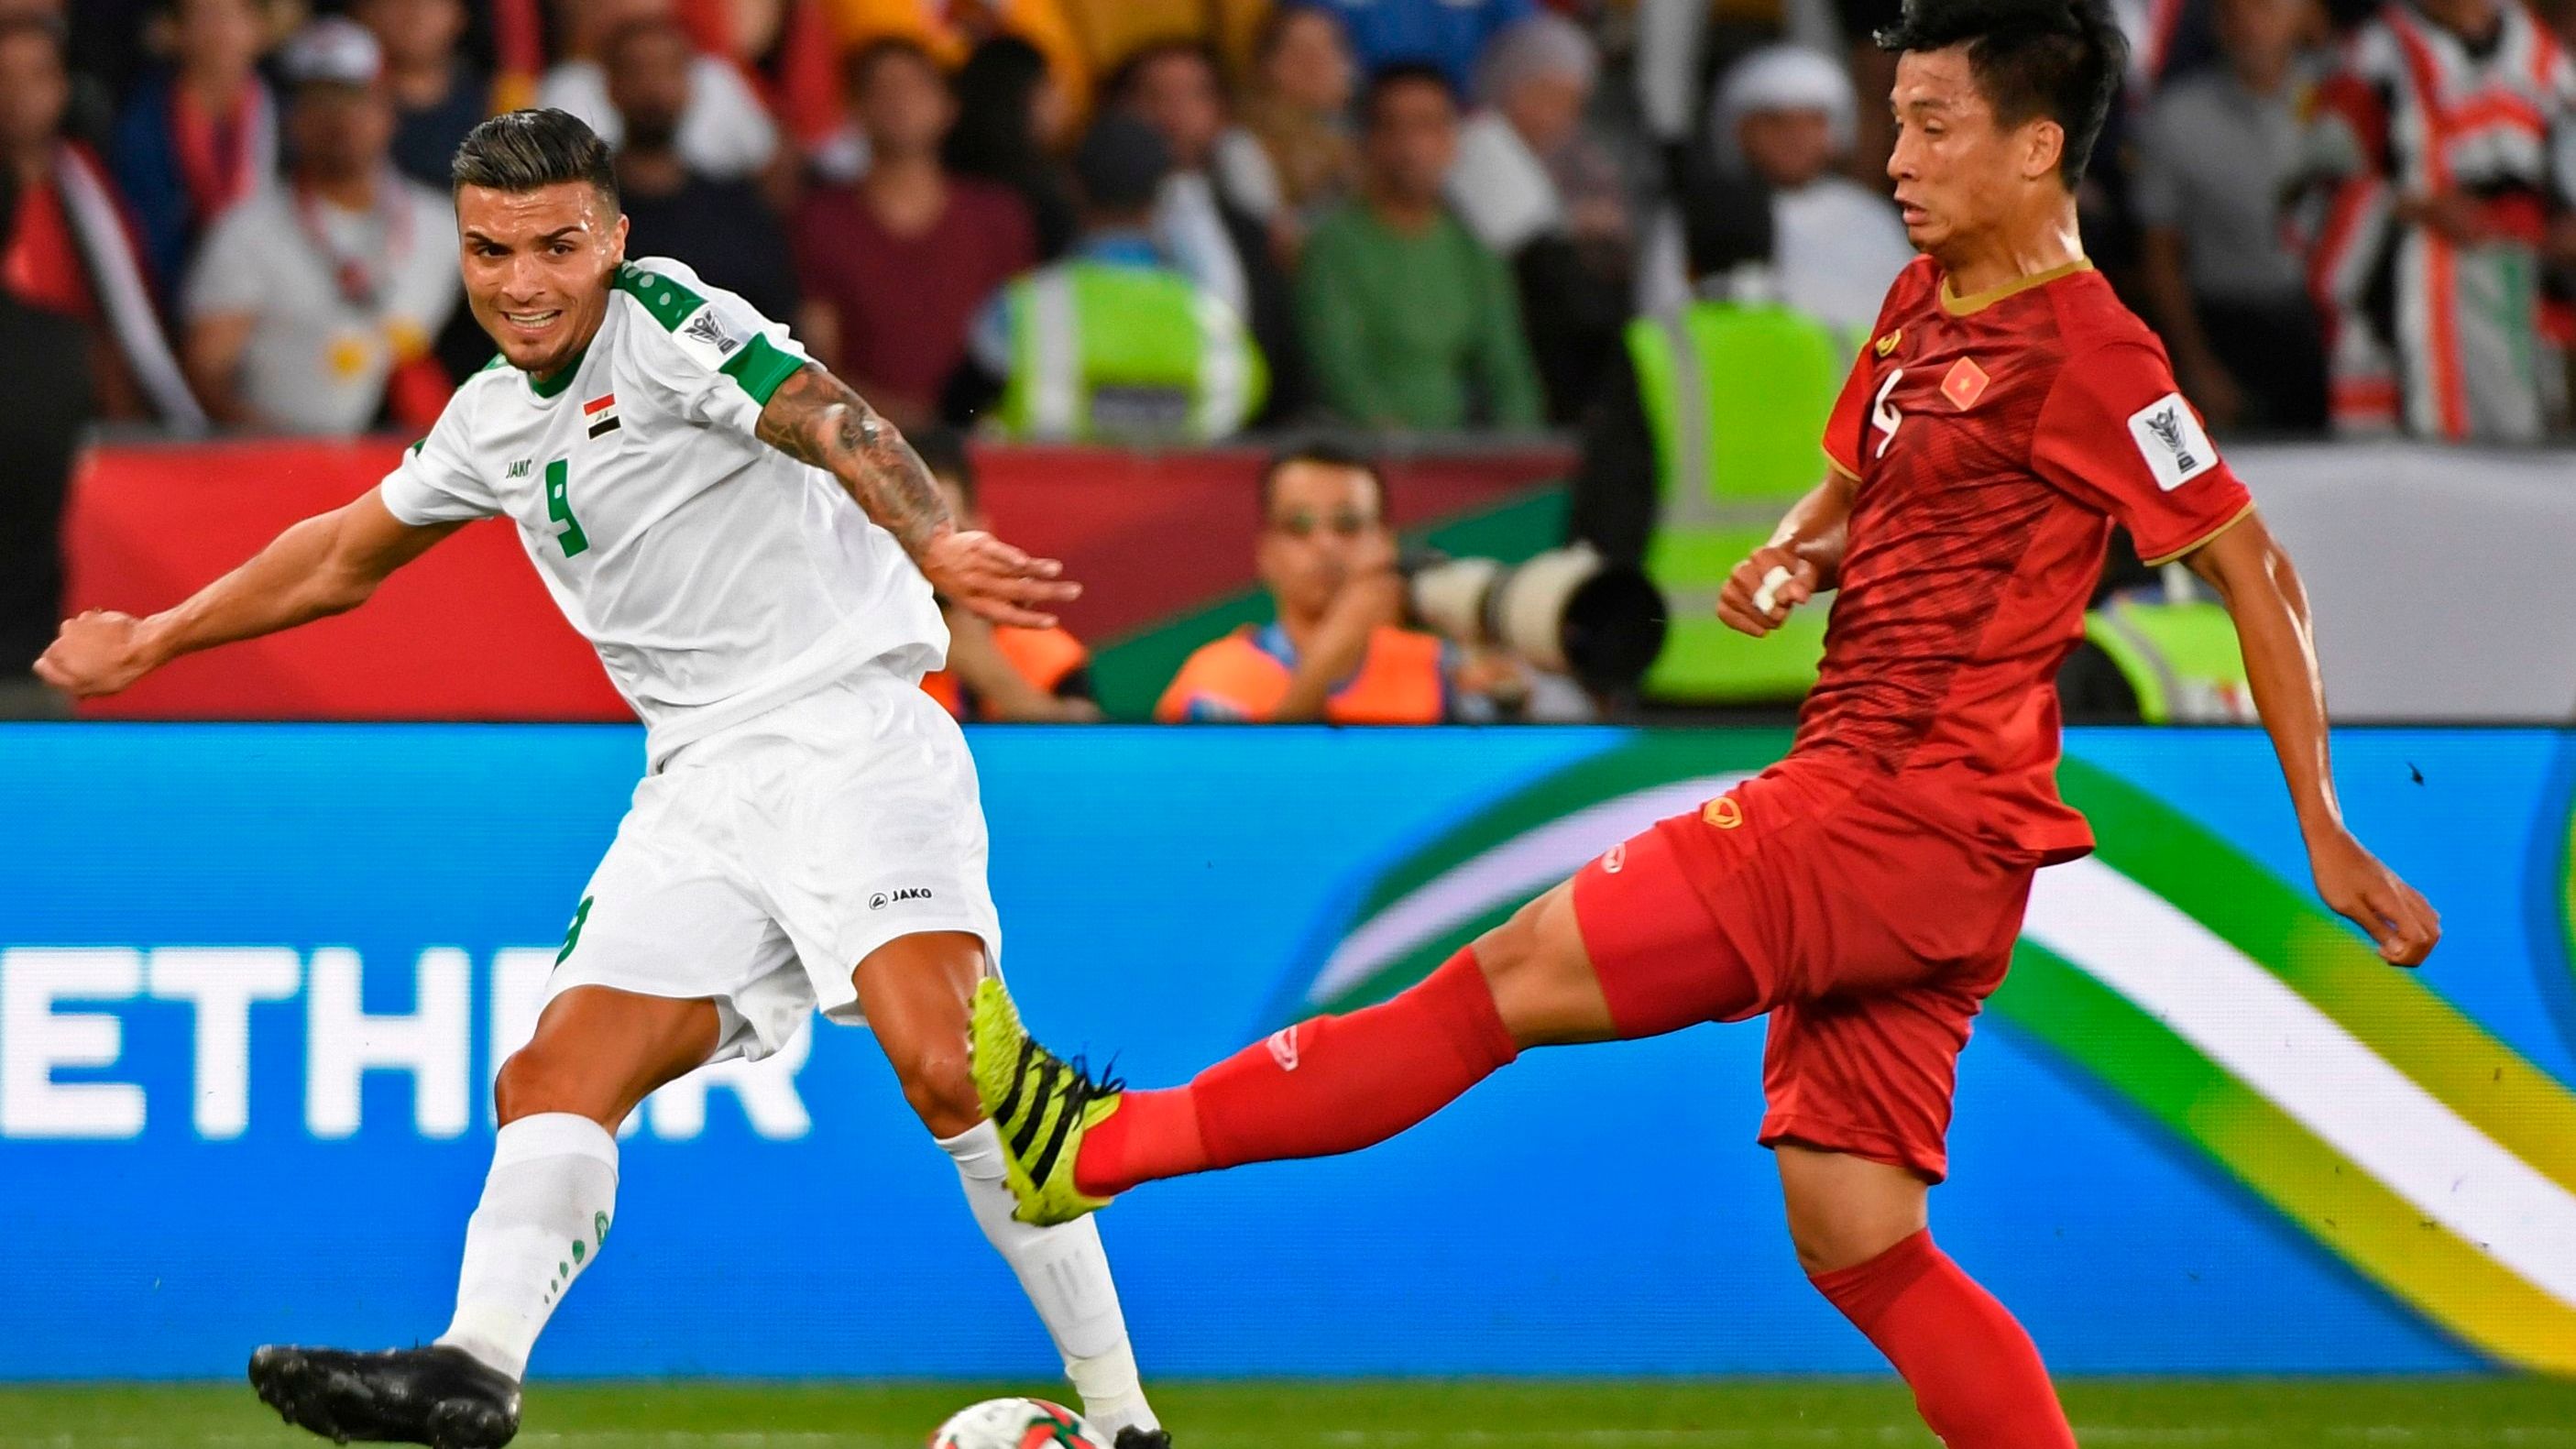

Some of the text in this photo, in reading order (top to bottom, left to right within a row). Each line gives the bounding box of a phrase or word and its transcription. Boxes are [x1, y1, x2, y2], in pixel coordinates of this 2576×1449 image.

[1871, 368, 1903, 458] 4
[545, 458, 589, 558] 9
[892, 888, 932, 902] JAKO
